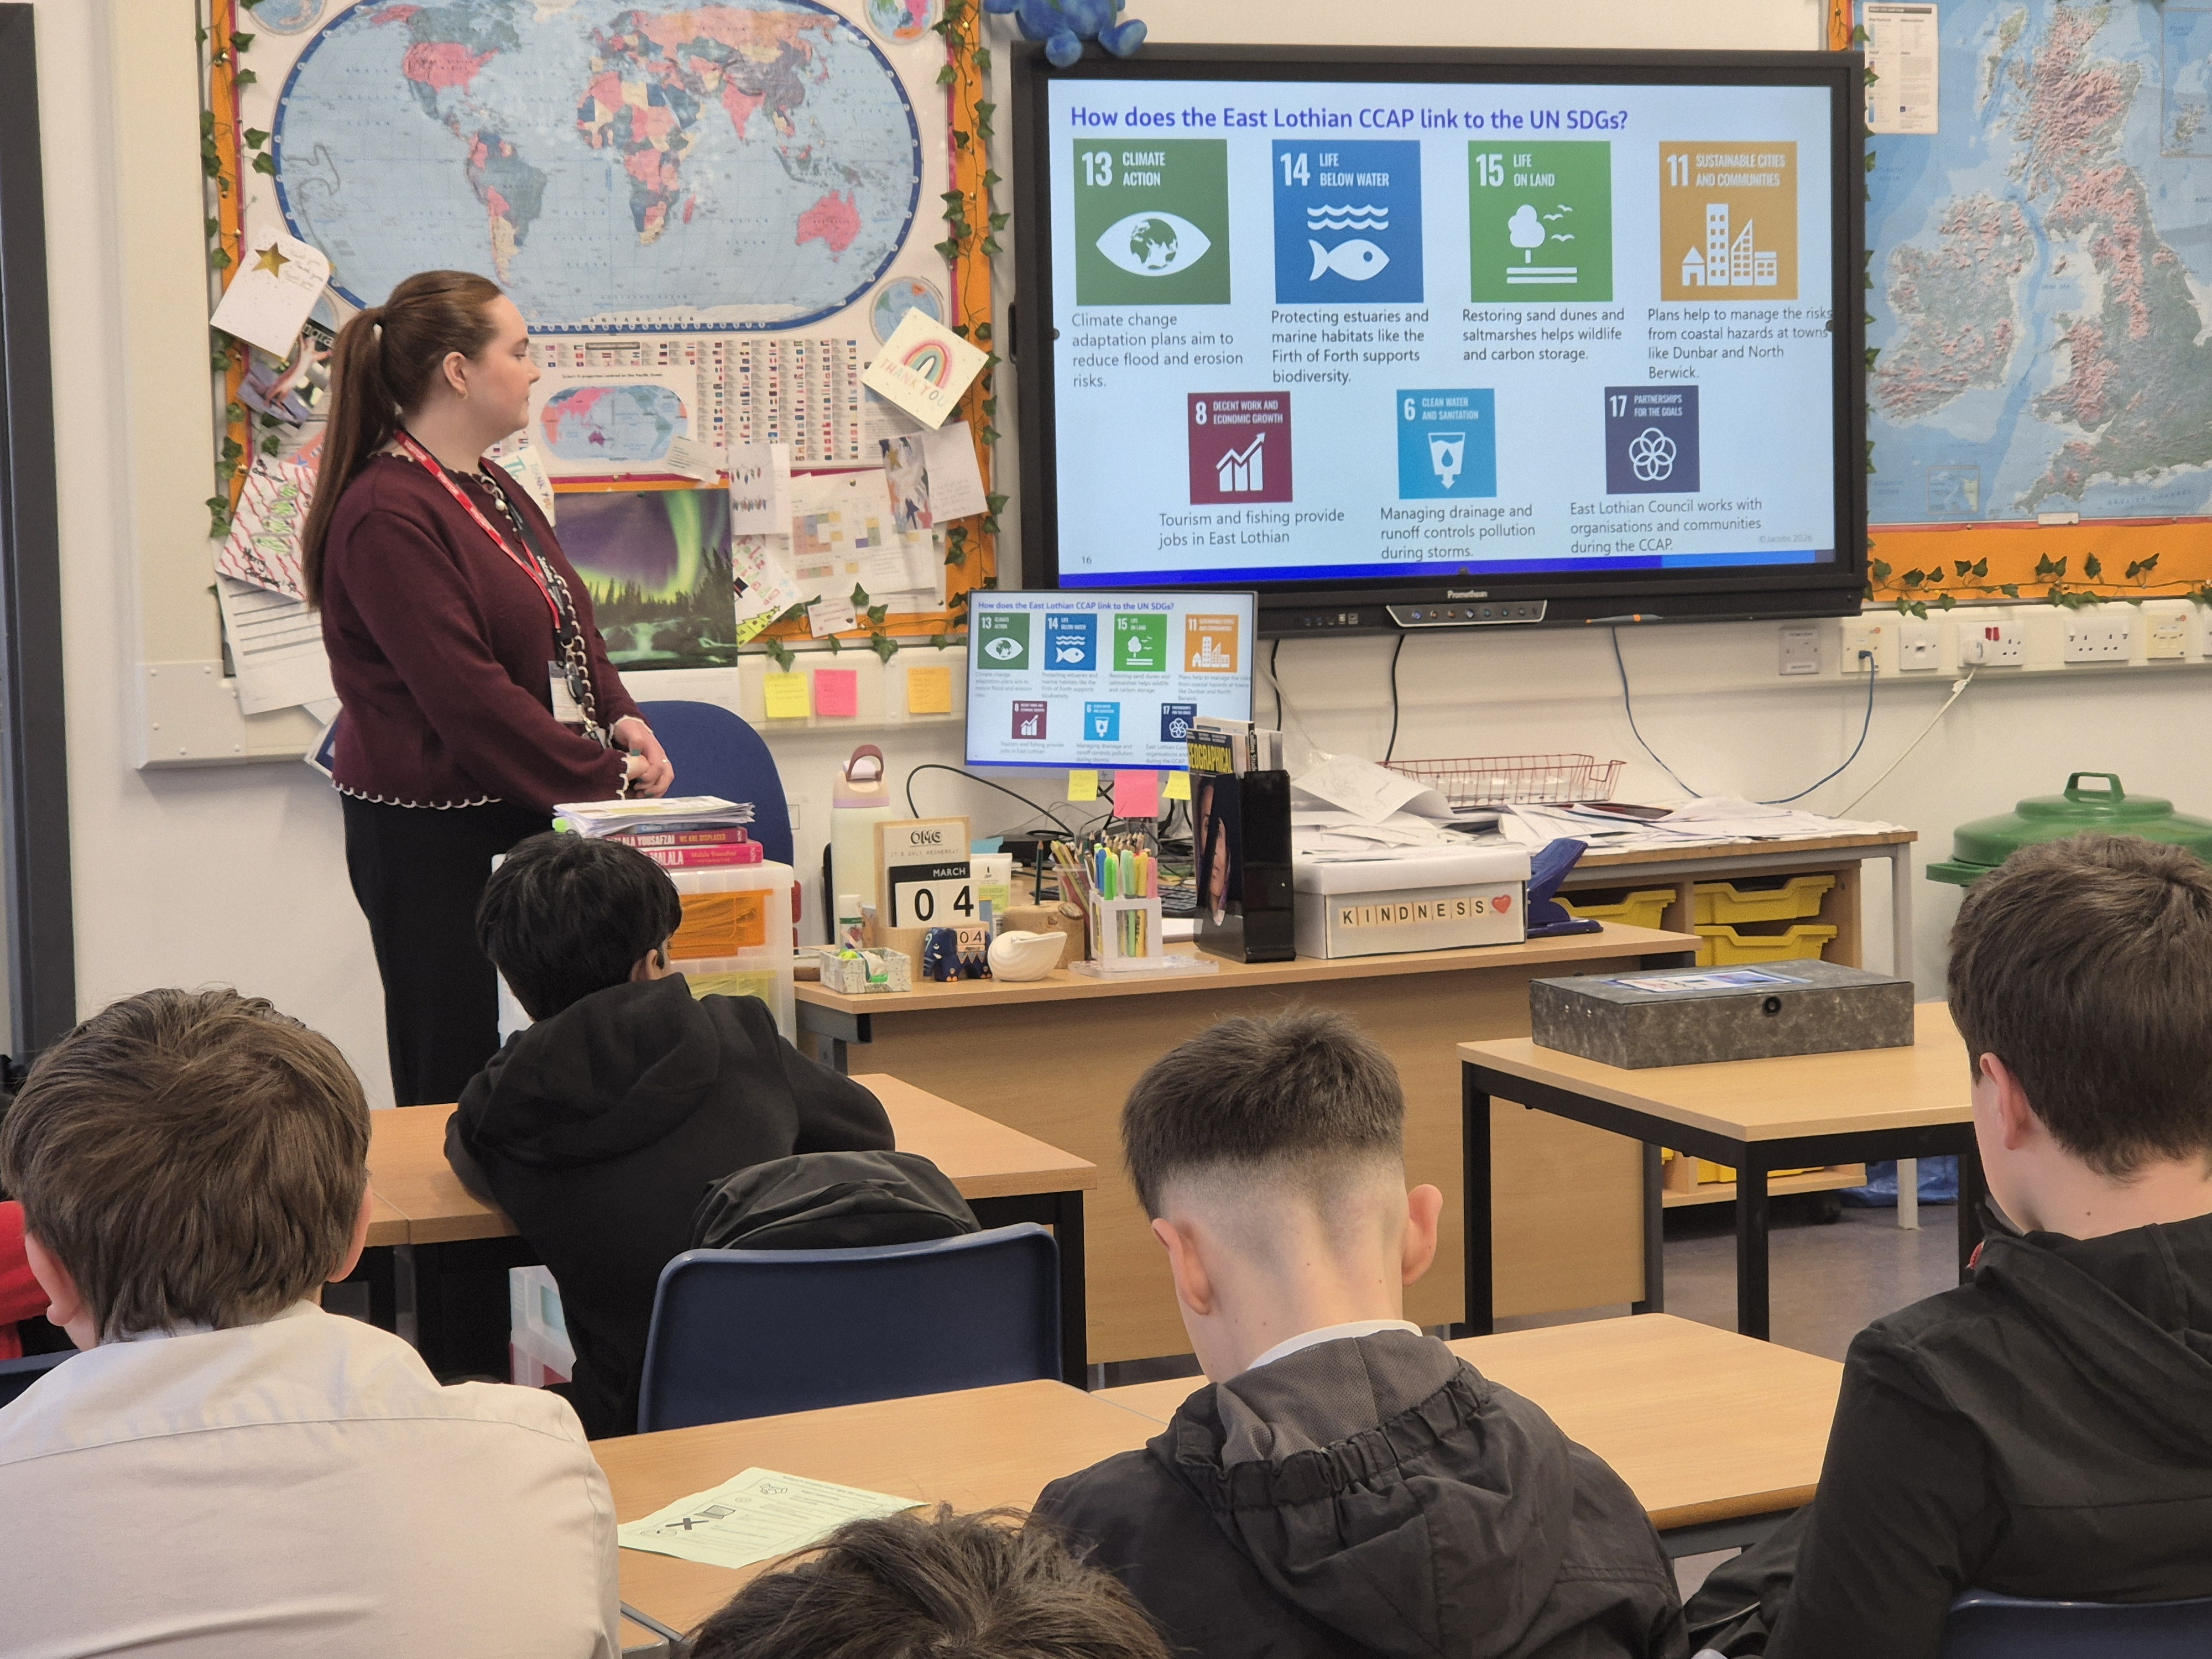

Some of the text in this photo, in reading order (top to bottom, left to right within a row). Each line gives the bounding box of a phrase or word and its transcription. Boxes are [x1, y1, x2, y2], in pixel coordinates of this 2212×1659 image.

[1072, 107, 1629, 131] How does the East Lothian CCAP link to the UN SDGs?
[1123, 152, 1166, 167] CLIMATE
[1319, 153, 1340, 168] LIFE
[1514, 154, 1533, 168] LIFE
[1696, 154, 1786, 169] SUSTAINABLE CITIES
[1082, 152, 1113, 187] 13
[1281, 153, 1311, 187] 14
[1476, 154, 1505, 187] 15
[1667, 154, 1689, 187] 11
[1123, 172, 1161, 187] ACTION
[1320, 173, 1390, 187] BELOW WATER
[1514, 173, 1556, 187] ON LAND
[1696, 173, 1781, 187] AND COMMUNITIES
[1072, 313, 1178, 330] Climate change
[1272, 309, 1430, 327] Protecting estuaries and
[1463, 308, 1625, 324] Restoring sand dunes and
[1648, 307, 1832, 324] Plans help to manage the risks
[1072, 331, 1234, 351] adaptation plans aim to
[1272, 329, 1425, 343] marine habitats like the
[1463, 327, 1623, 343] saltmarshes helps wildlife
[1648, 325, 1827, 341] from coastal hazards at towns
[1073, 351, 1244, 368] reduce flood and erosion
[1272, 349, 1421, 366] Firth of Forth supports
[1463, 347, 1588, 362] and carbon storage.
[1649, 345, 1785, 360] like Dunbar and North
[1074, 374, 1107, 388] risks.
[1273, 369, 1352, 387] biodiversity.
[1649, 366, 1698, 380] Berwick.
[879, 358, 949, 408] THANK YOU
[1213, 399, 1279, 412] DECENT WORK AND
[1422, 397, 1469, 408] CLEAN WATER
[1610, 395, 1628, 418] 17
[1634, 394, 1683, 404] PARTNERSHIPS
[1196, 401, 1208, 426] 8
[1404, 398, 1416, 421] 6
[1422, 410, 1479, 421] AND SANITATION
[1635, 406, 1683, 418] FOR THE GOALS
[1213, 414, 1284, 425] ECONOMIC GROWTH
[1381, 504, 1533, 523] Managing drainage and
[1571, 497, 1763, 516] East Lothian Council works with
[1160, 508, 1345, 528] Tourism and fishing provide
[1381, 523, 1536, 541] runoff controls pollution
[1571, 518, 1762, 538] organisations and communities
[1159, 530, 1290, 551] jobs in East Lothian
[1571, 540, 1673, 557] during the CCAP.
[1082, 556, 1093, 565] 16
[1381, 545, 1474, 561] during storms.
[978, 602, 995, 610] How
[1076, 602, 1097, 610] CCAP
[1123, 603, 1136, 611] the
[1151, 603, 1175, 611] SDGs?
[637, 834, 675, 846] YOUSAFZAI
[910, 830, 942, 844] OMG
[933, 867, 966, 878] MARCH
[1343, 900, 1484, 925] KINDNESS
